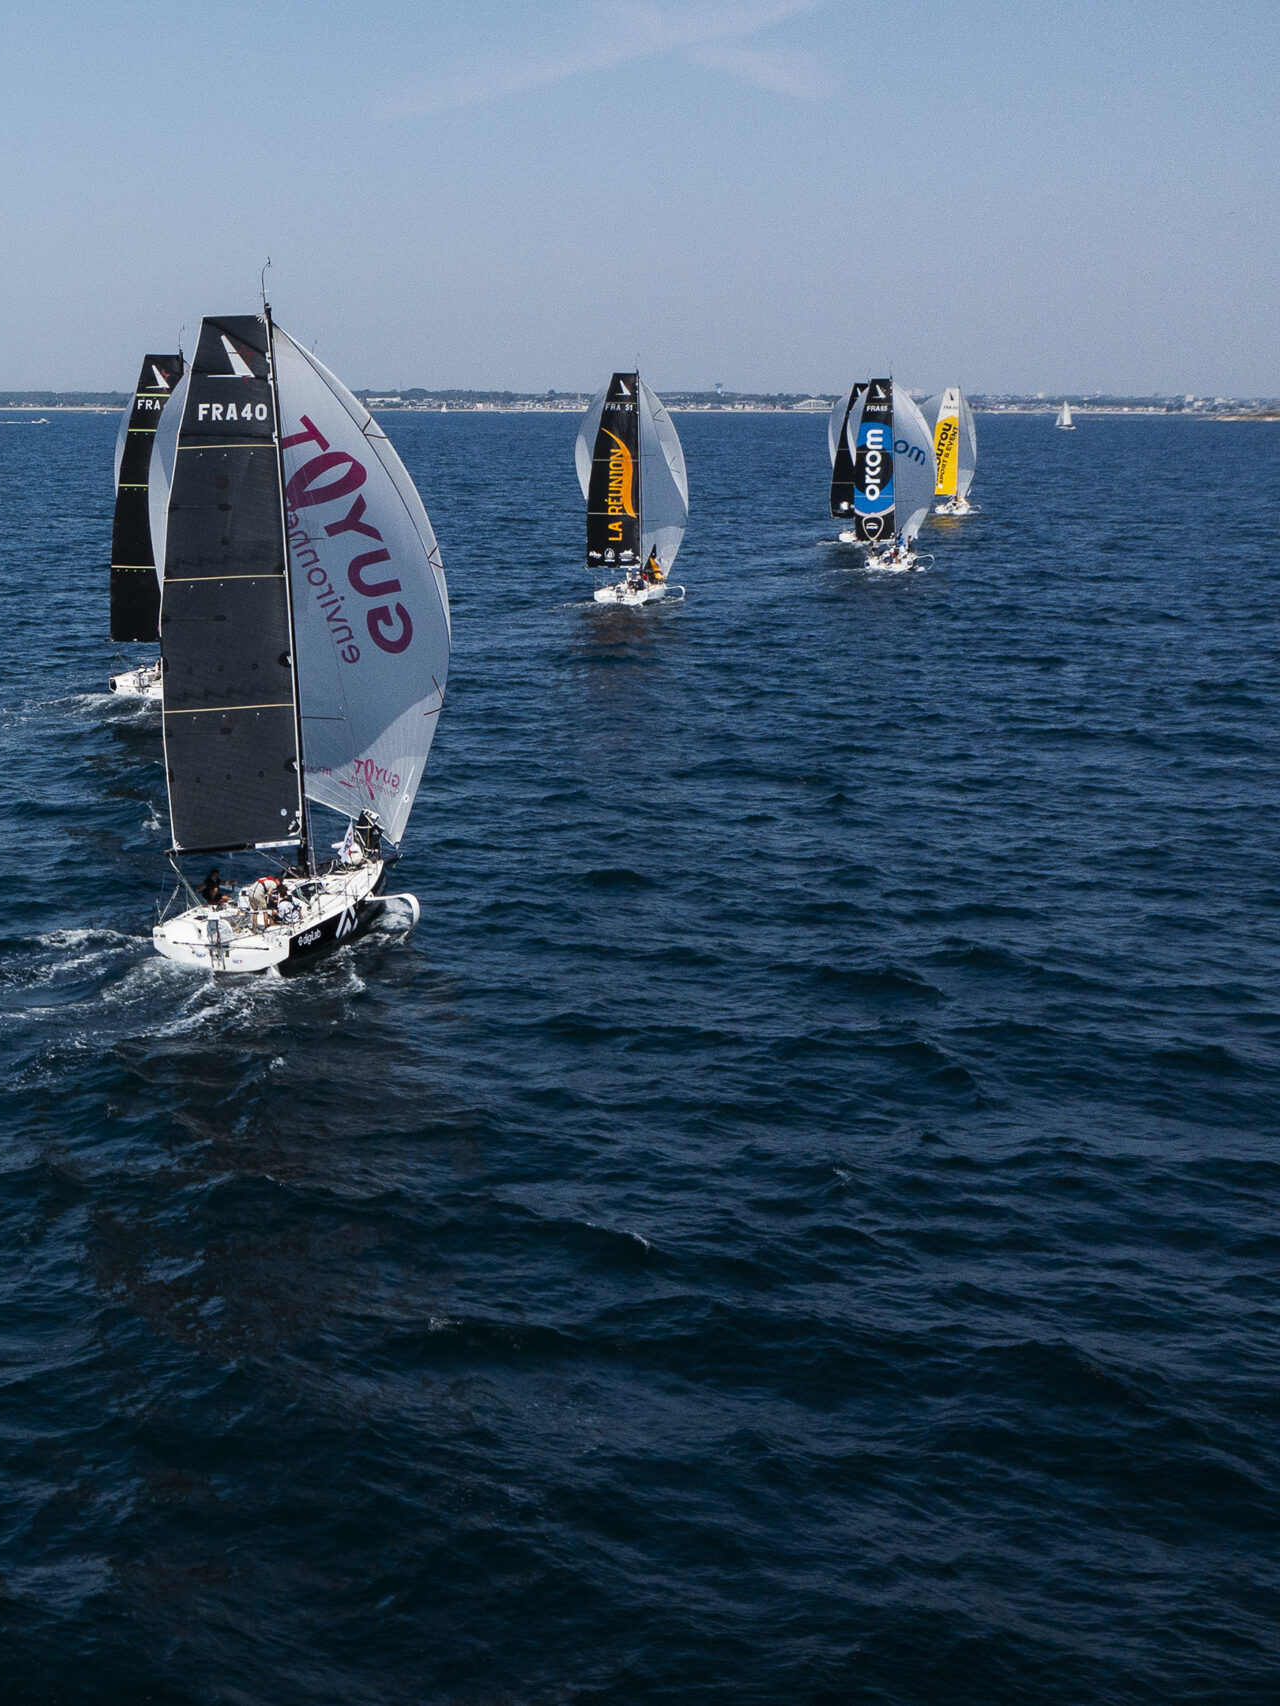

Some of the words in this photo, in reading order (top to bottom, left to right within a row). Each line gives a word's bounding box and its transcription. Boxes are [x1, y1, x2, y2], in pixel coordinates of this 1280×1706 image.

[137, 399, 161, 411] FRA
[197, 403, 268, 422] FRA40
[605, 403, 621, 411] FRA
[946, 426, 958, 452] EVENT
[865, 428, 884, 501] orcom
[605, 448, 625, 516] RÉUNION
[608, 521, 623, 541] LA
